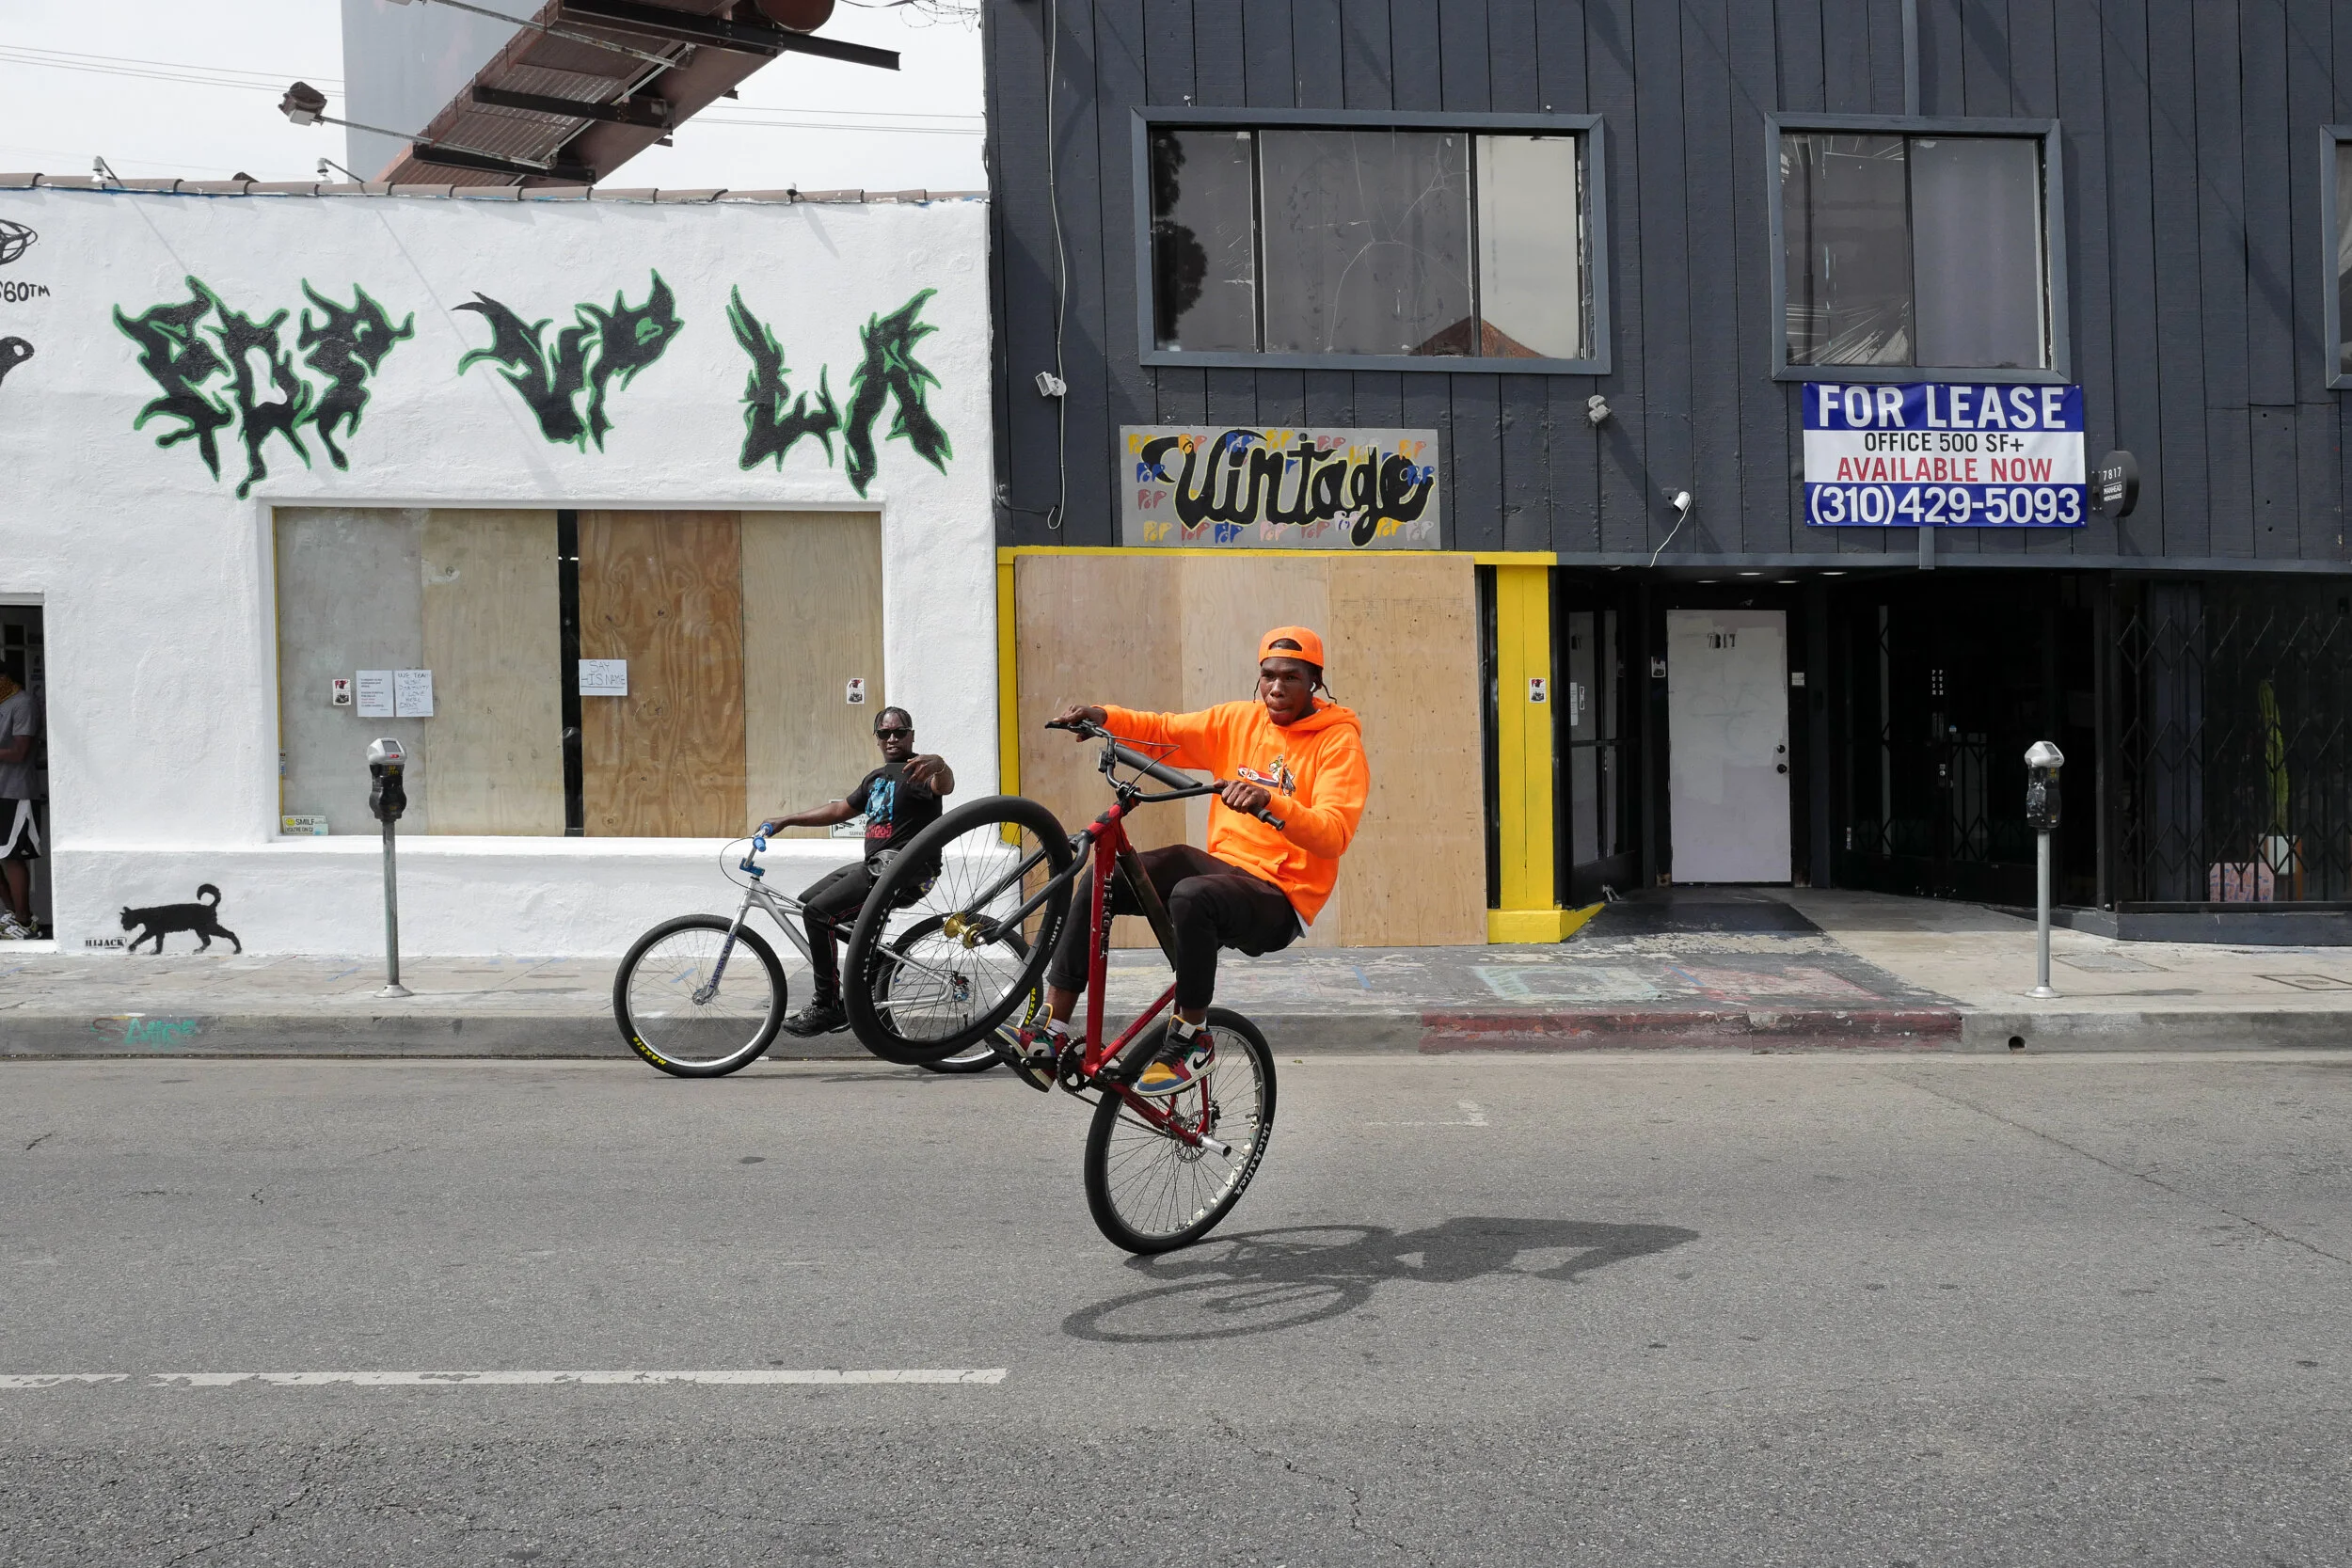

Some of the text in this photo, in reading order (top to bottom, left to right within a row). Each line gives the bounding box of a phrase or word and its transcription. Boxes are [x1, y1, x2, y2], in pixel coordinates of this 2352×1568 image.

[1819, 385, 2065, 429] FOR LEASE
[1865, 432, 2025, 452] OFFICE 500 SF+
[1836, 457, 2053, 483] AVAILABLE NOW
[2103, 467, 2122, 481] 7817
[1141, 429, 1435, 546] Vintage
[2104, 483, 2122, 495] MANHEAD
[1811, 484, 2081, 525] (310)429-5093
[589, 660, 610, 673] SAY
[580, 673, 626, 686] HIS NAME
[85, 939, 124, 947] HIJACK
[1025, 987, 1036, 1025] MAXXIS
[632, 1037, 667, 1066] MAXXIS
